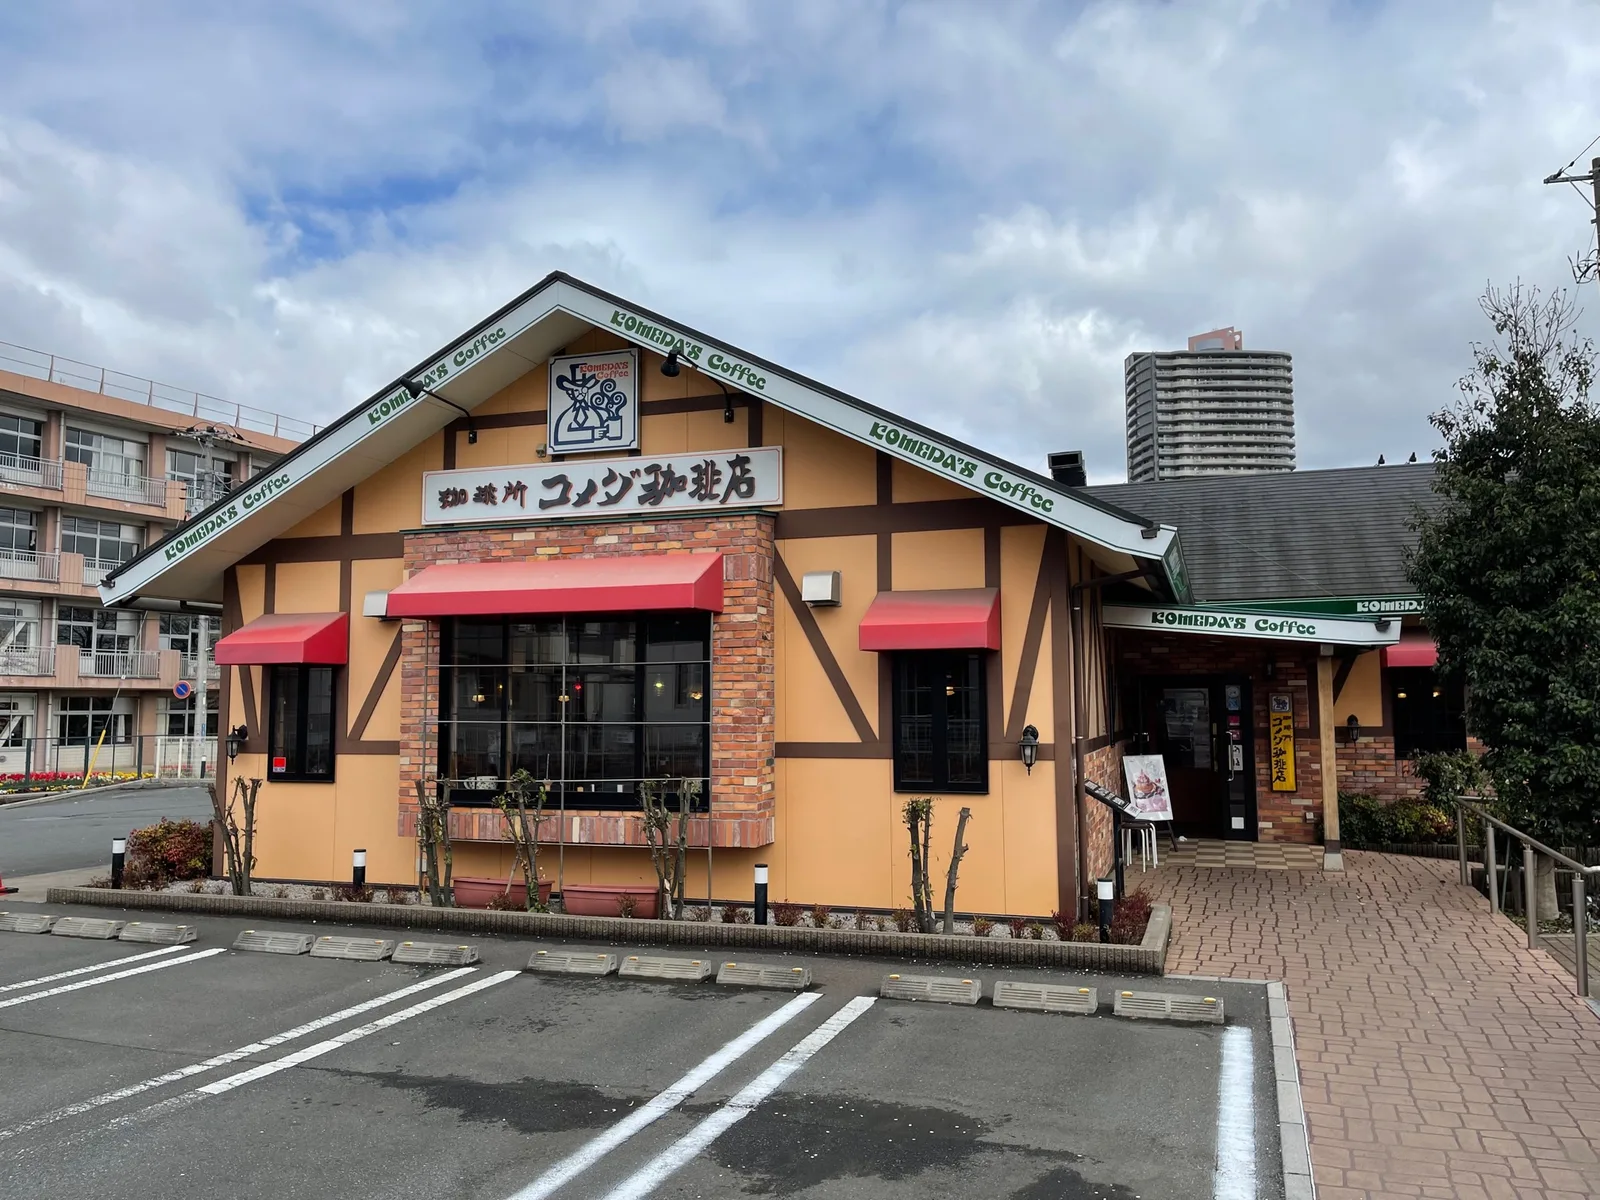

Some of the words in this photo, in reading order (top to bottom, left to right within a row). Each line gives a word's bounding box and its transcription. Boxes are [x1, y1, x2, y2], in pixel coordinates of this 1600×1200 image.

[367, 363, 449, 425] KOMEA'S
[453, 327, 507, 367] Coffee
[580, 361, 629, 373] KOMEDA'S
[596, 370, 629, 380] Coffee
[610, 310, 703, 360] KOMEDA'S
[707, 354, 767, 390] Coffee
[538, 454, 756, 510] コメダ珈琲店
[869, 421, 978, 479] KOMEDA'S
[984, 471, 1054, 512] Coffee
[164, 505, 239, 561] KOMEDA'S
[242, 473, 291, 510] Coffee
[1151, 611, 1247, 630] KOMEDA'S
[1255, 619, 1316, 635] Coffee
